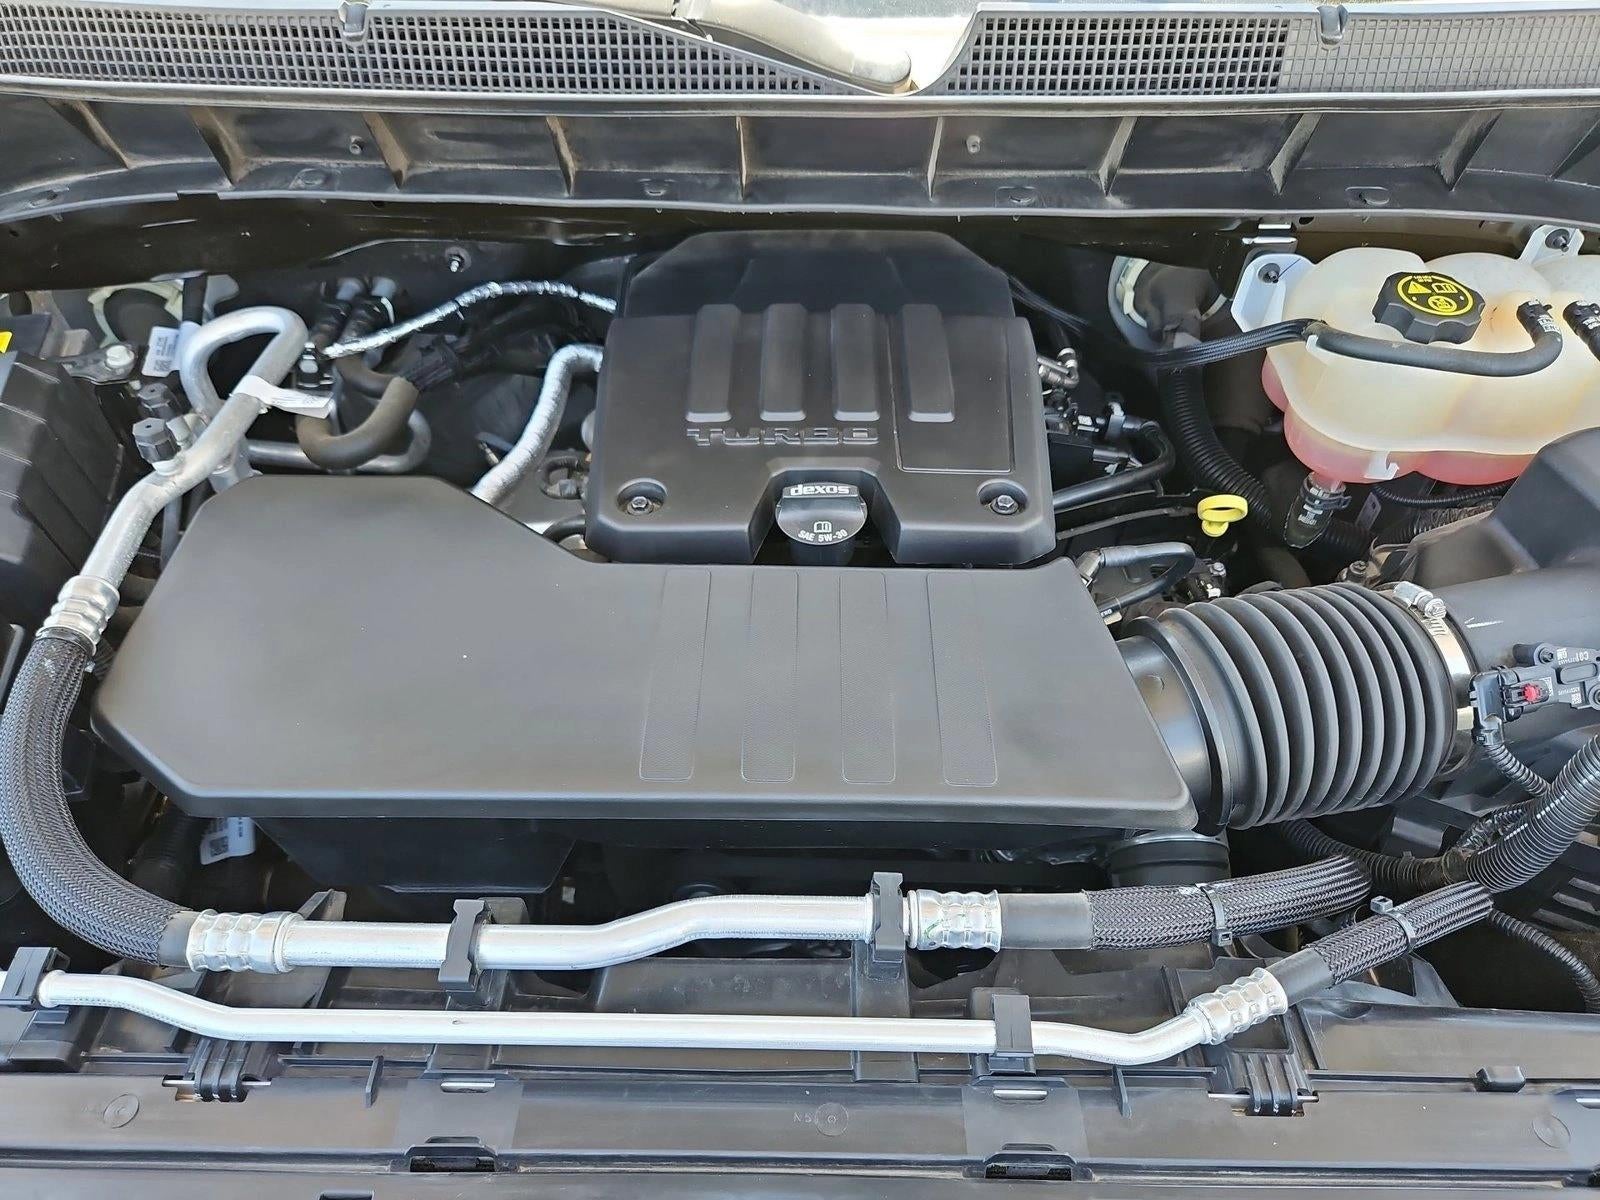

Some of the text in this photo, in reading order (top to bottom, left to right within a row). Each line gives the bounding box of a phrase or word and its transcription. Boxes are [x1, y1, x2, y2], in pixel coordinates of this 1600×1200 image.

[687, 427, 879, 446] TURBO
[790, 484, 850, 496] dexos
[798, 528, 848, 542] SAE 5W-30
